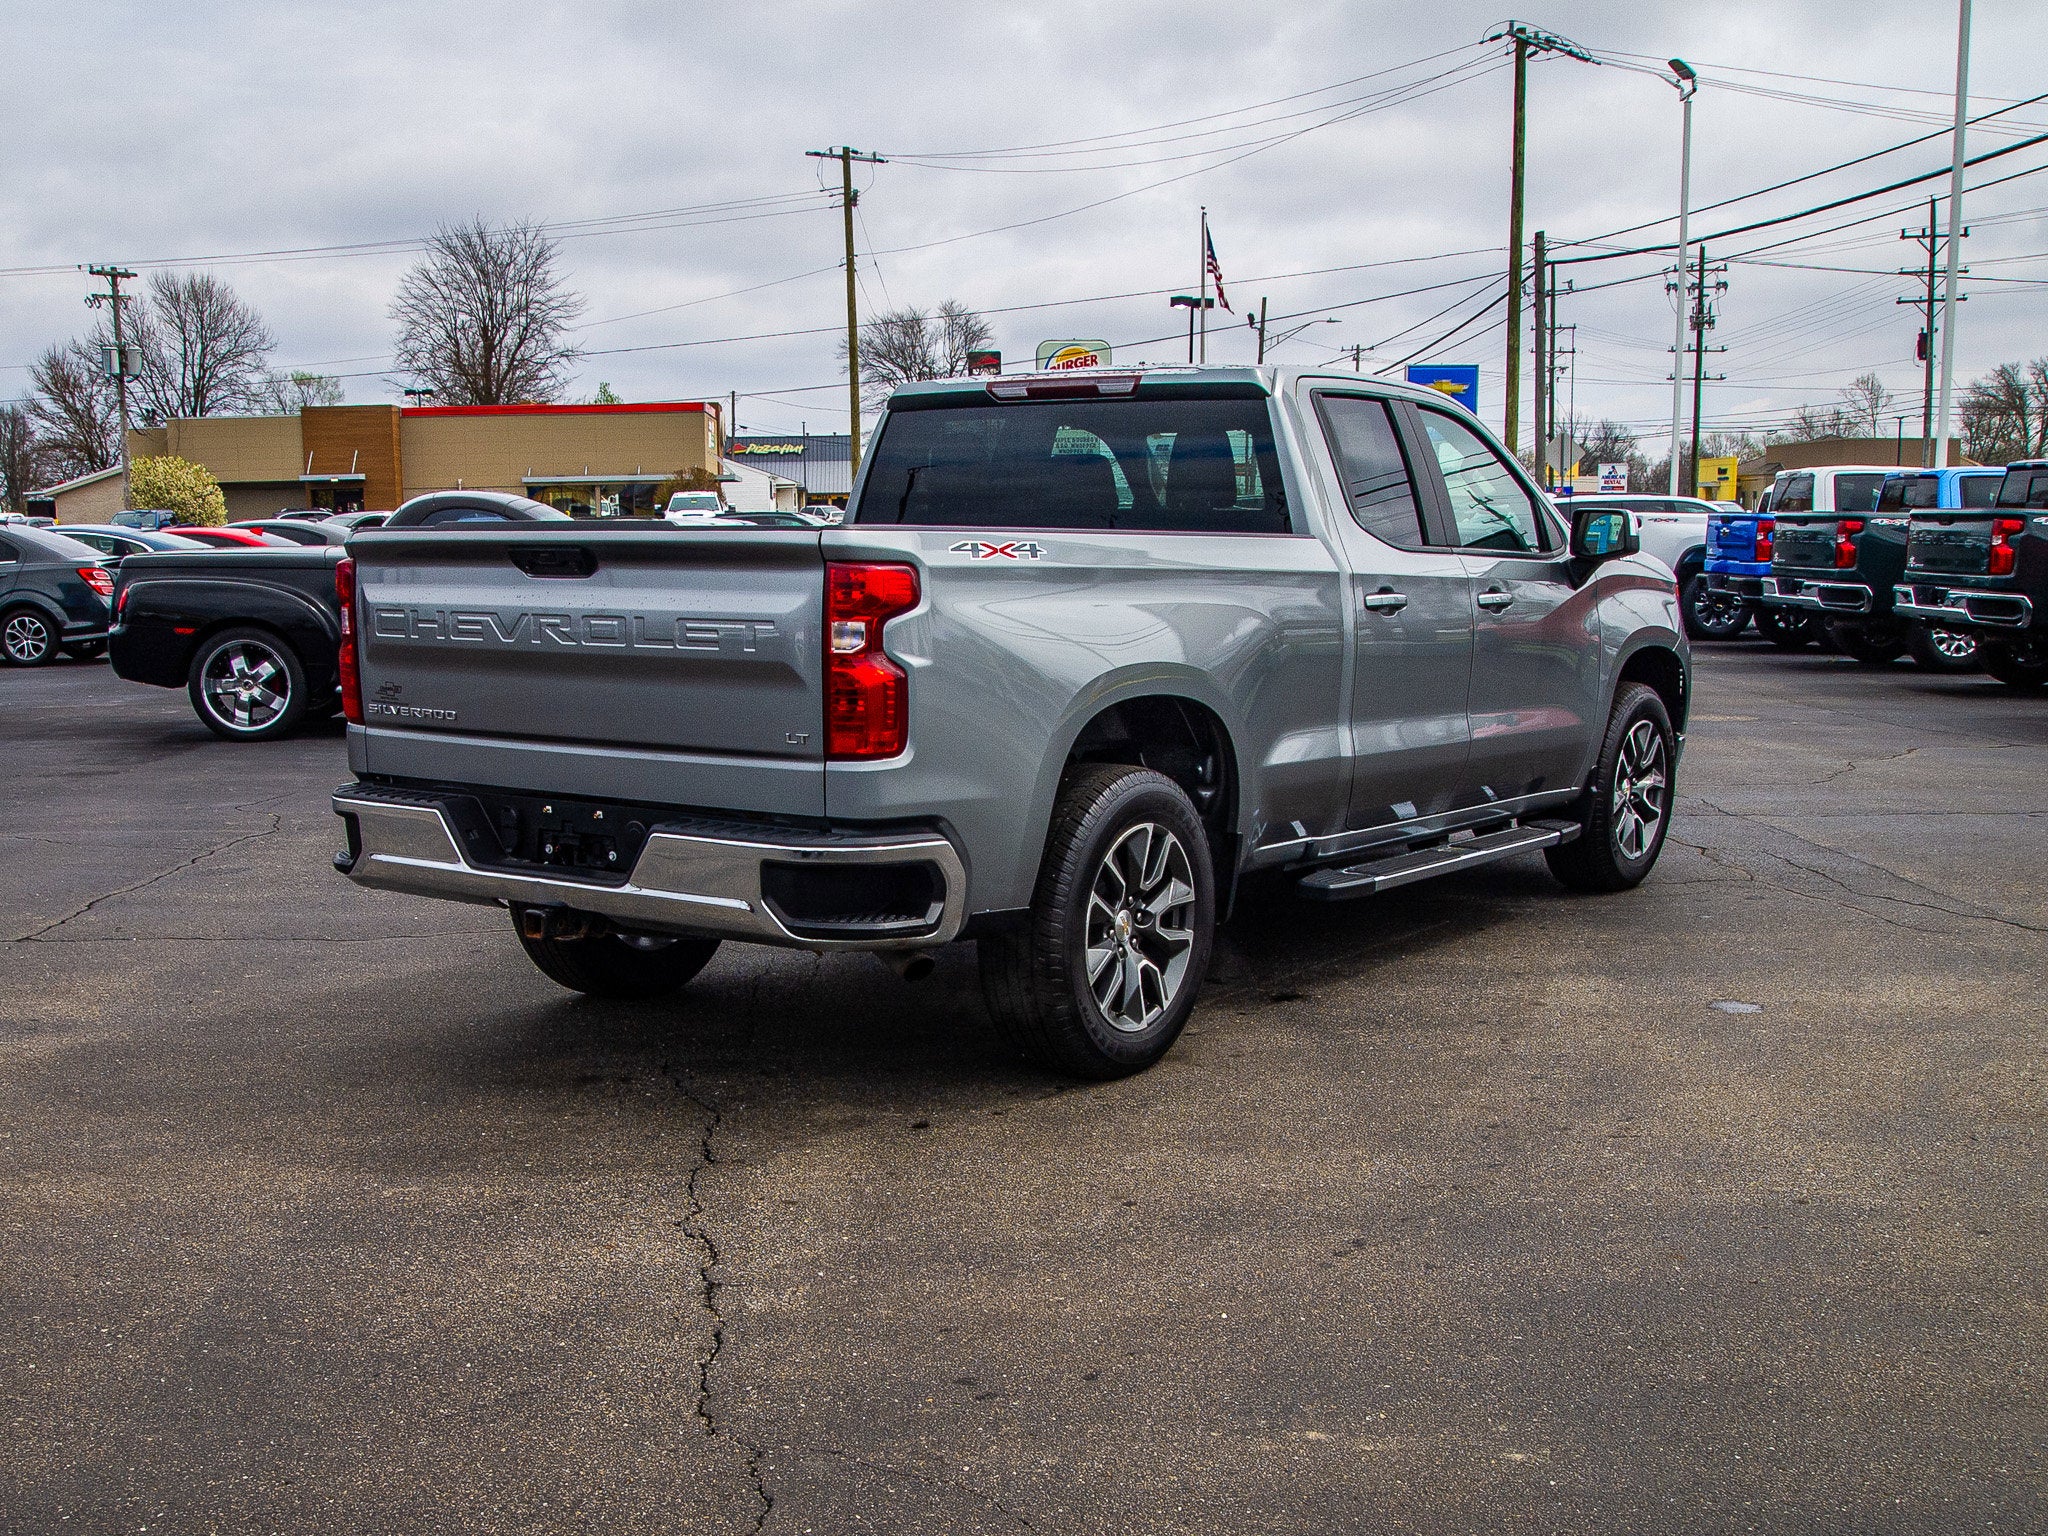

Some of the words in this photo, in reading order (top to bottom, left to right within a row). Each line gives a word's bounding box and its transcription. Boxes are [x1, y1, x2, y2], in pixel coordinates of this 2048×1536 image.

[746, 443, 780, 455] Pizza
[780, 443, 804, 455] Hut
[375, 609, 775, 651] CHEVROLET
[368, 703, 458, 720] SILVERADO
[785, 732, 810, 744] LT
